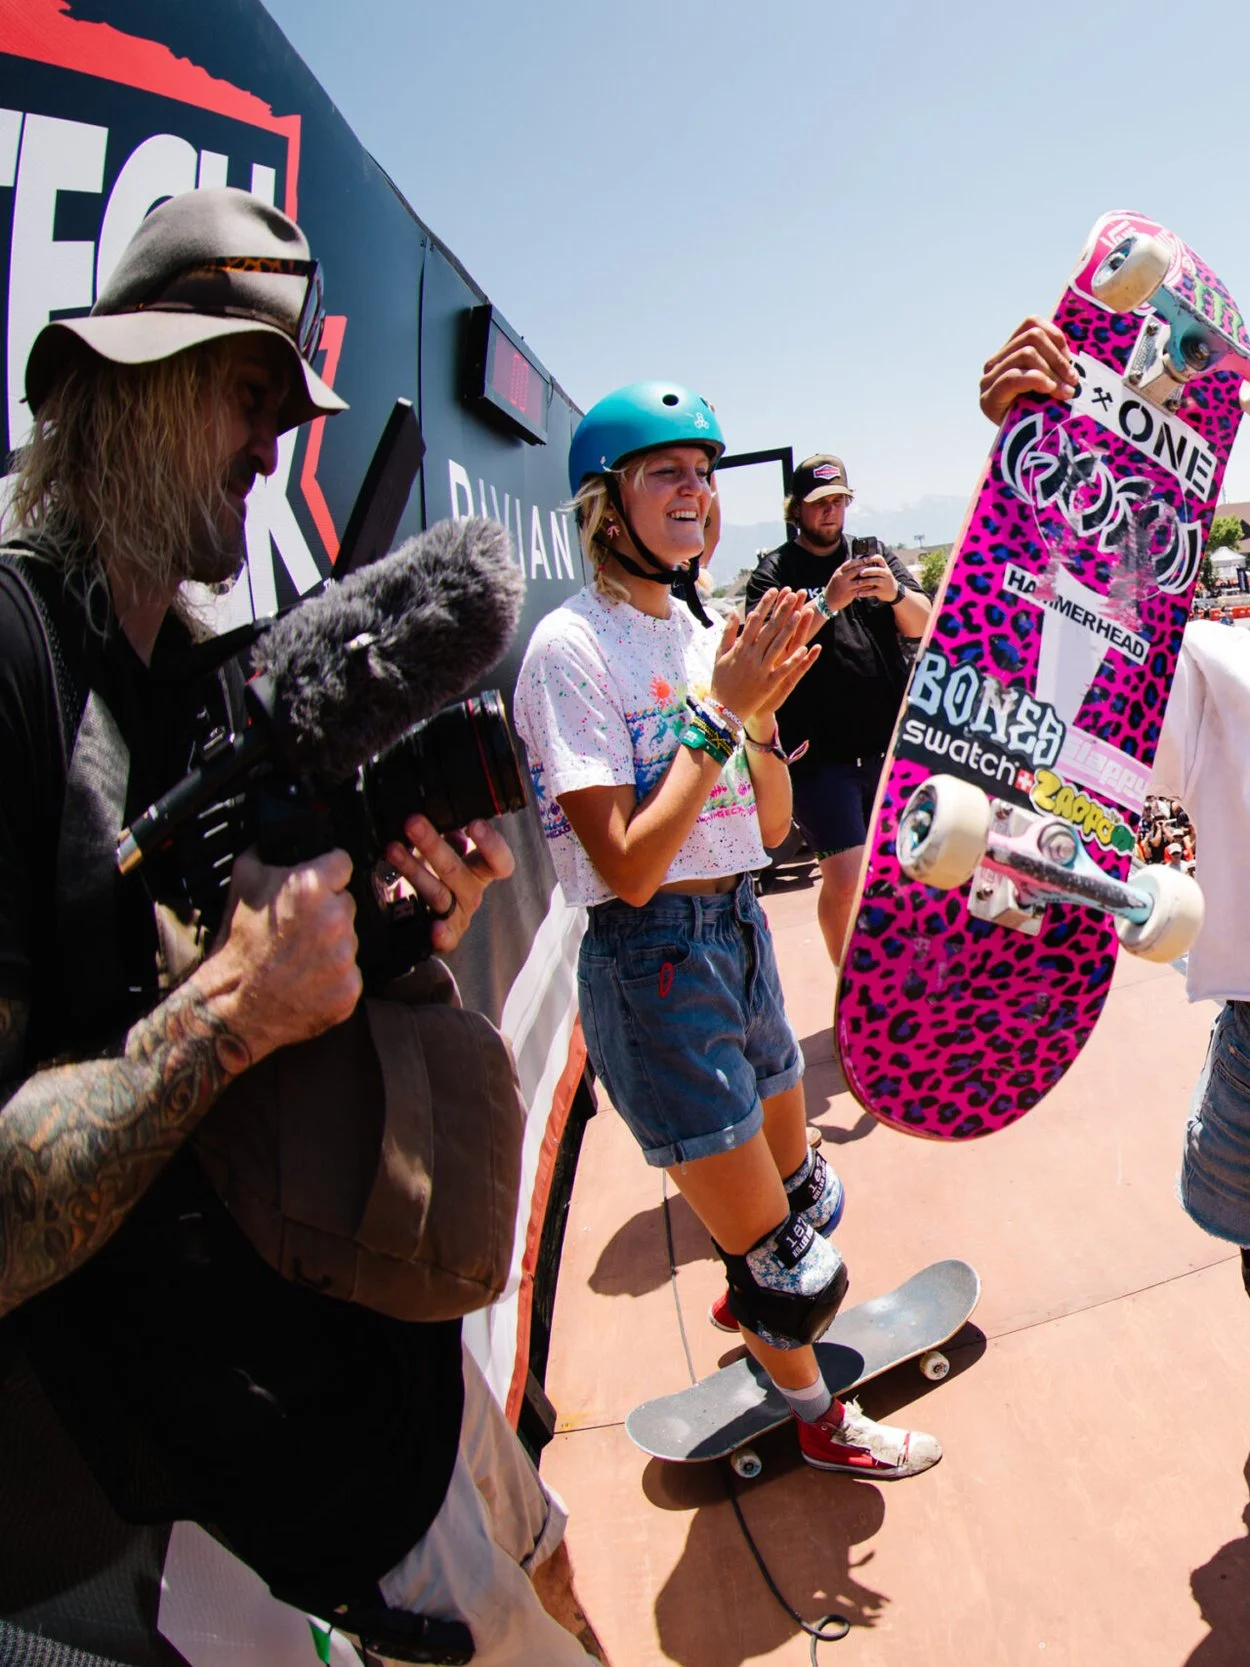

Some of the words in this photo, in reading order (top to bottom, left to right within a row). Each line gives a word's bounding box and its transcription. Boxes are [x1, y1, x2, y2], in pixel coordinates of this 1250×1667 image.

[1008, 569, 1145, 659] HAMERHEAD
[908, 651, 1064, 766] BONES
[902, 719, 1019, 786] swatch
[786, 1216, 809, 1248] 187
